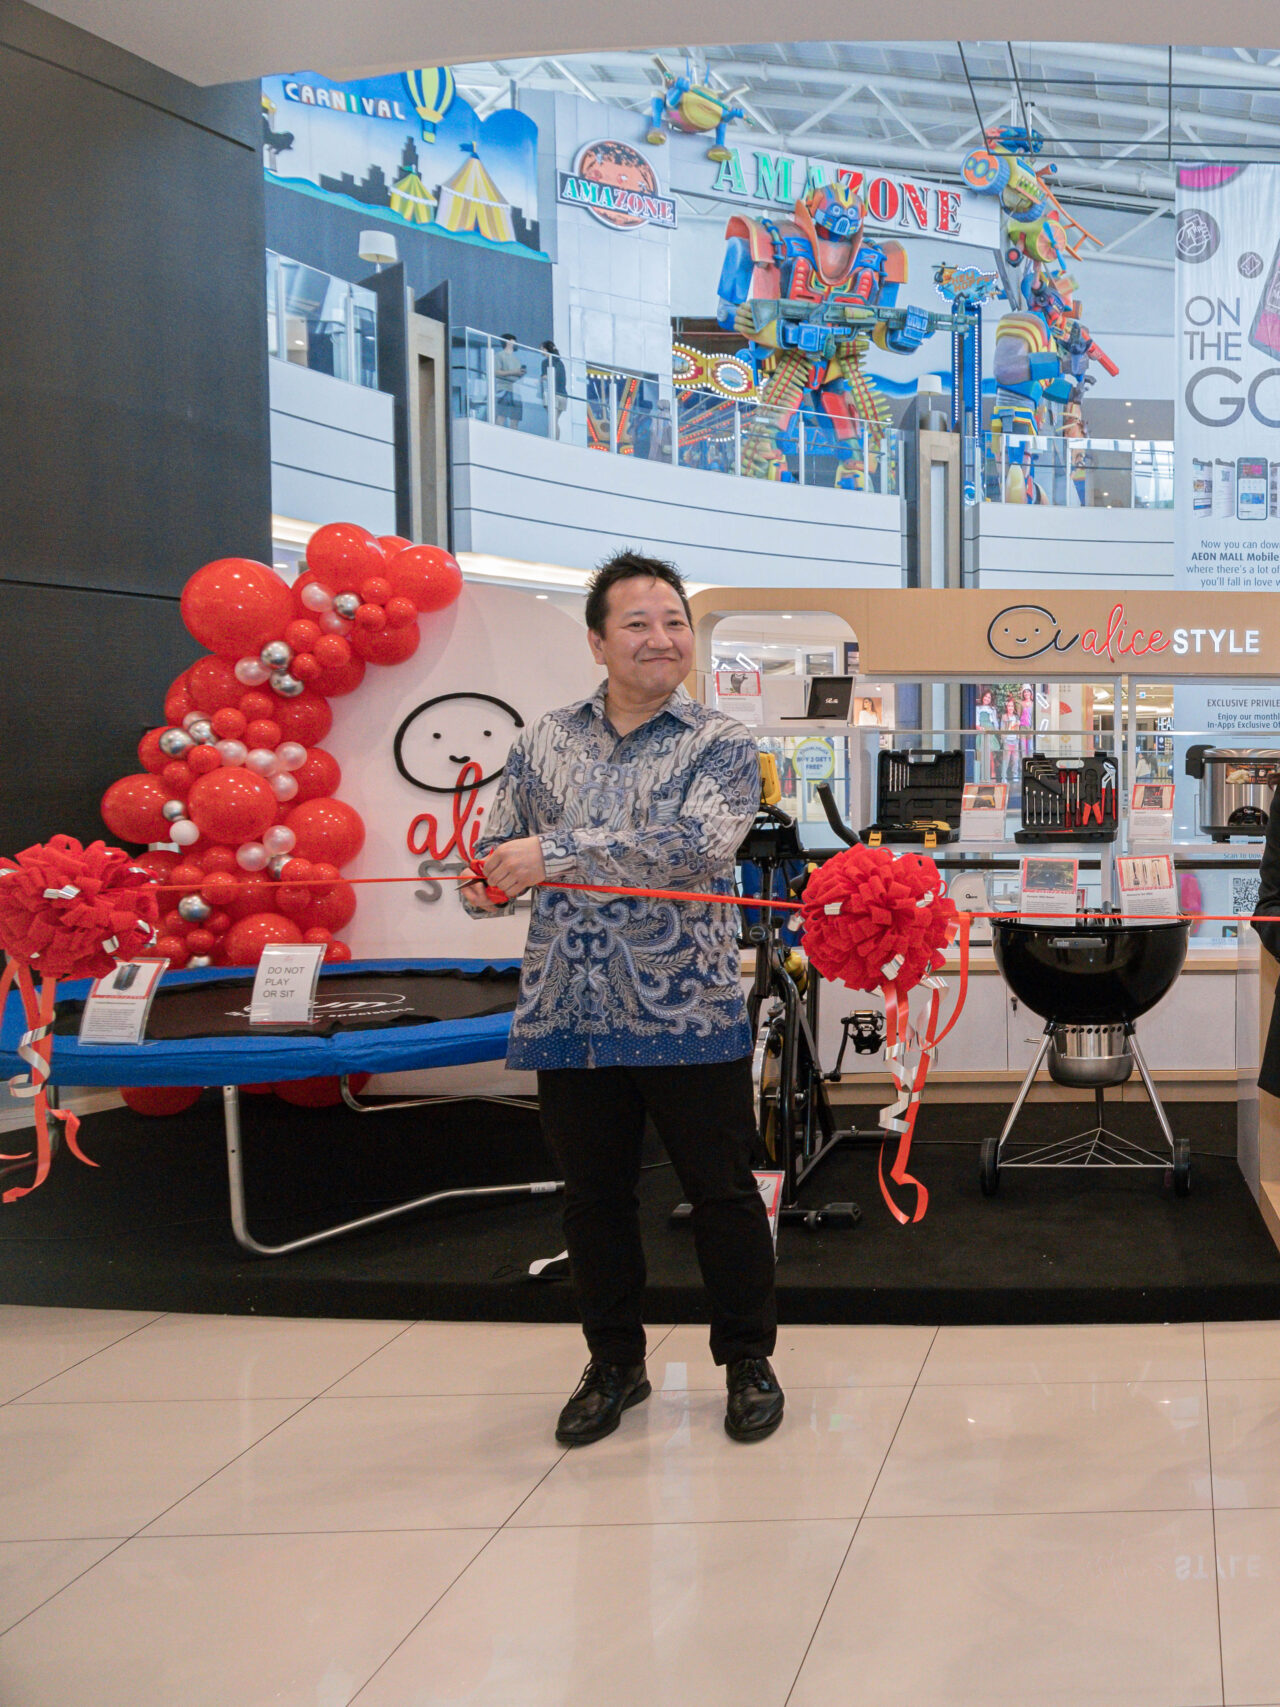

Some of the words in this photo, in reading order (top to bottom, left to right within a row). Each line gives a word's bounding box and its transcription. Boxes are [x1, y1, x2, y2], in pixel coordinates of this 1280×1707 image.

[285, 82, 406, 120] CARNIVAL
[563, 177, 674, 222] AMAZONE
[1185, 295, 1241, 327] ON
[1184, 331, 1242, 362] THE
[1201, 540, 1221, 549] Now
[1224, 542, 1240, 551] you
[1191, 552, 1217, 561] AEON
[1219, 552, 1245, 561] MALL
[1246, 552, 1280, 561] Mobile
[1186, 564, 1214, 574] where
[1216, 564, 1247, 574] there's
[1249, 566, 1255, 574] a
[1257, 564, 1269, 574] lot
[1271, 564, 1280, 574] of
[1201, 577, 1225, 588] you'll
[1227, 577, 1241, 587] fall
[1243, 577, 1252, 587] in
[1254, 577, 1273, 587] love
[1081, 604, 1171, 663] alice
[1173, 628, 1260, 654] STYLE
[1207, 699, 1248, 708] EXCLUSIVE
[1217, 712, 1237, 722] Enjoy
[1207, 721, 1235, 730] In-Apps
[1237, 721, 1270, 729] Exclusive
[407, 762, 484, 863] ali
[267, 966, 283, 975] DO
[284, 966, 305, 975] NOT
[264, 978, 290, 987] PLAY
[262, 990, 278, 999] OR
[279, 990, 295, 999] SIT
